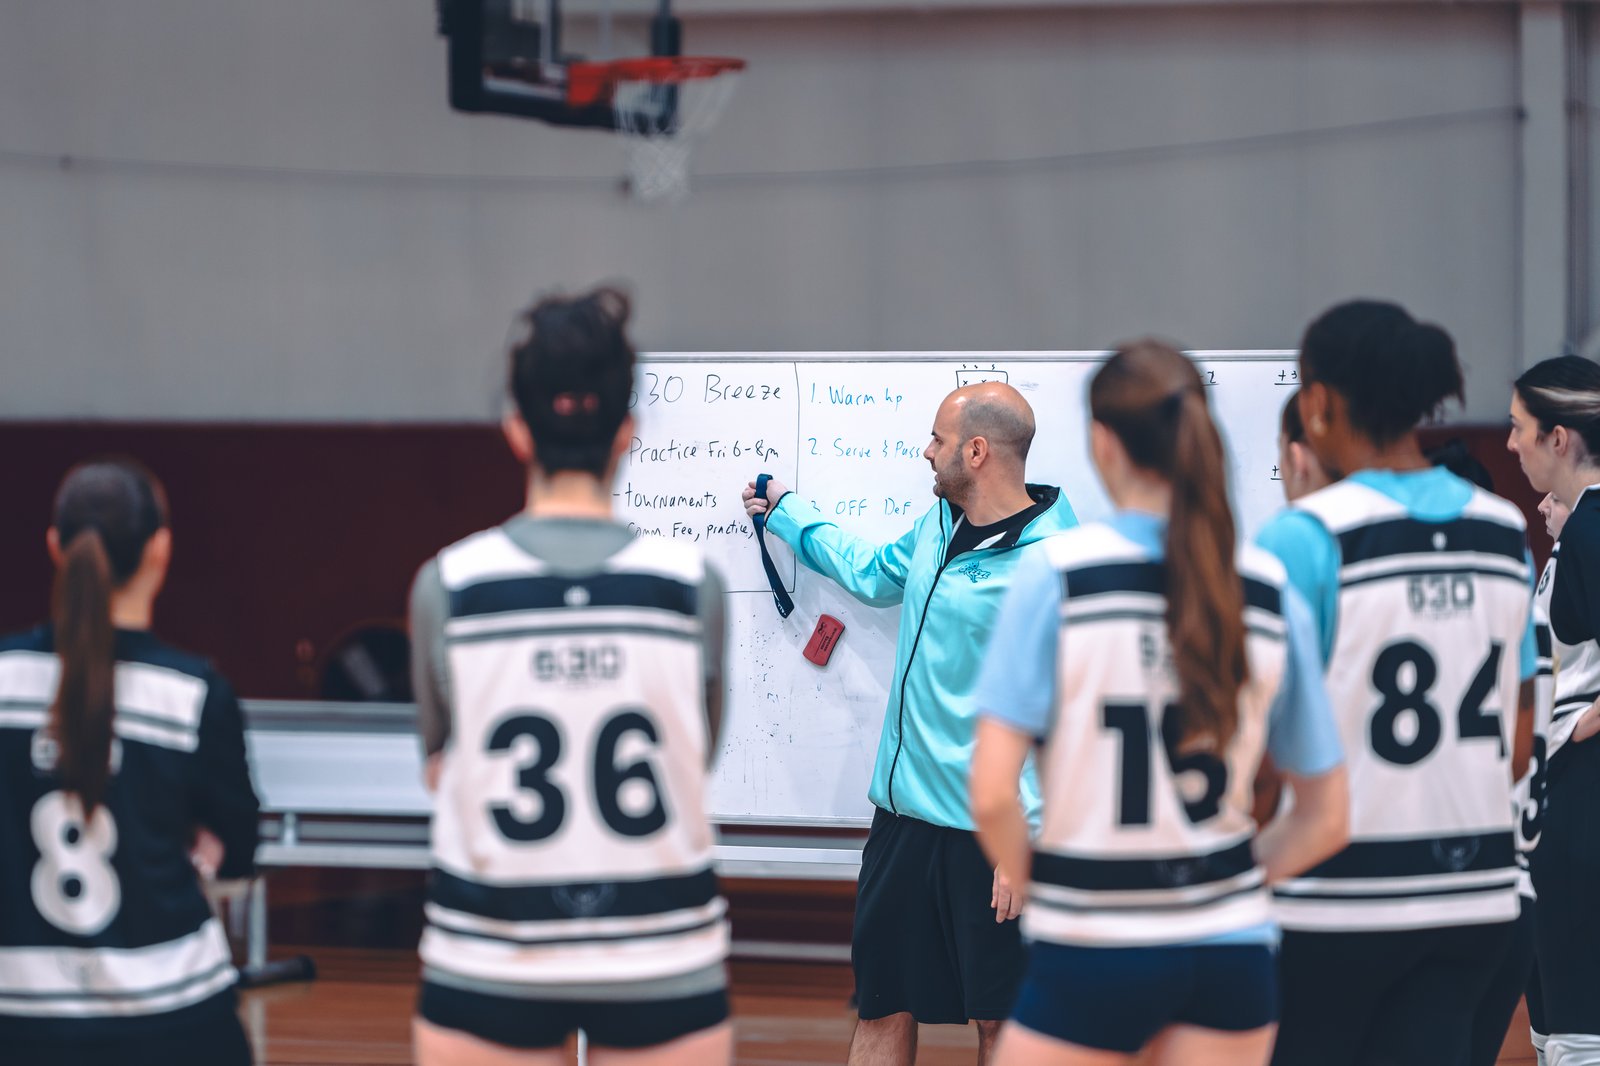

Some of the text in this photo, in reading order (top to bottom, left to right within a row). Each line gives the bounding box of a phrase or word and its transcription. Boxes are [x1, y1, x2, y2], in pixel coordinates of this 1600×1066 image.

[704, 373, 782, 404] Breeze
[829, 384, 876, 406] Warm
[630, 436, 697, 467] Practice
[708, 440, 728, 458] Fri
[833, 437, 872, 457] Serve
[894, 440, 921, 459] Pass
[1371, 640, 1505, 767] 84
[487, 709, 669, 842] 36
[30, 788, 121, 937] 8
